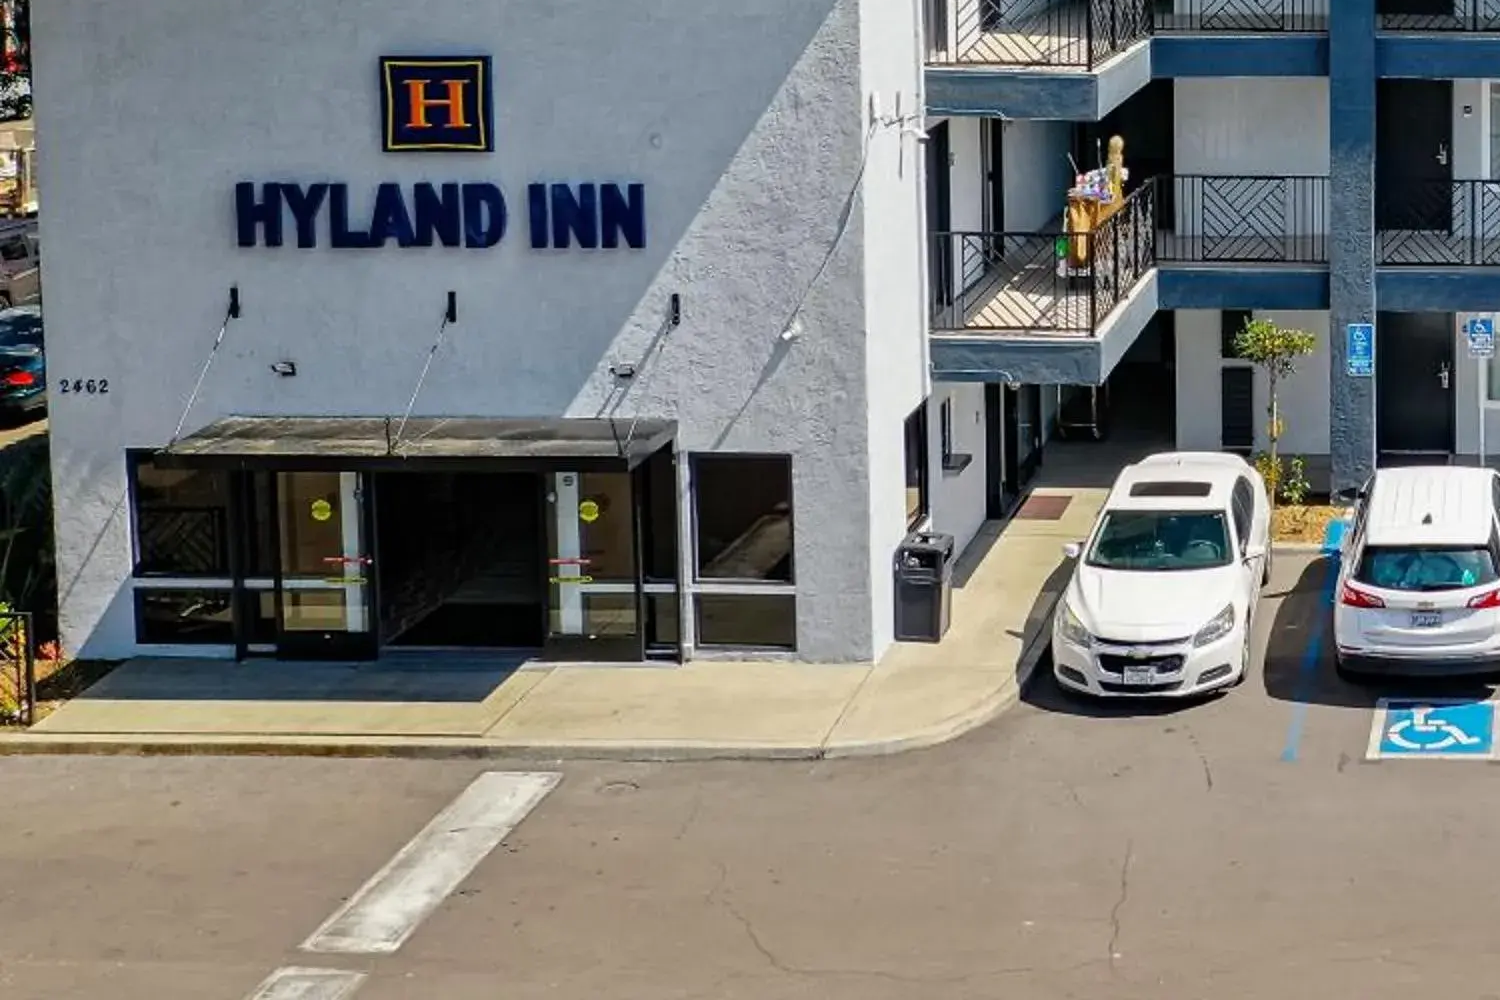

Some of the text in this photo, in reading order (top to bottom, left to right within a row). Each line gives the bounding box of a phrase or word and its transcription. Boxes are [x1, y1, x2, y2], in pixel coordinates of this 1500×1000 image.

[402, 79, 472, 129] H
[235, 181, 647, 249] HYLAND INN
[59, 379, 109, 394] 2462
